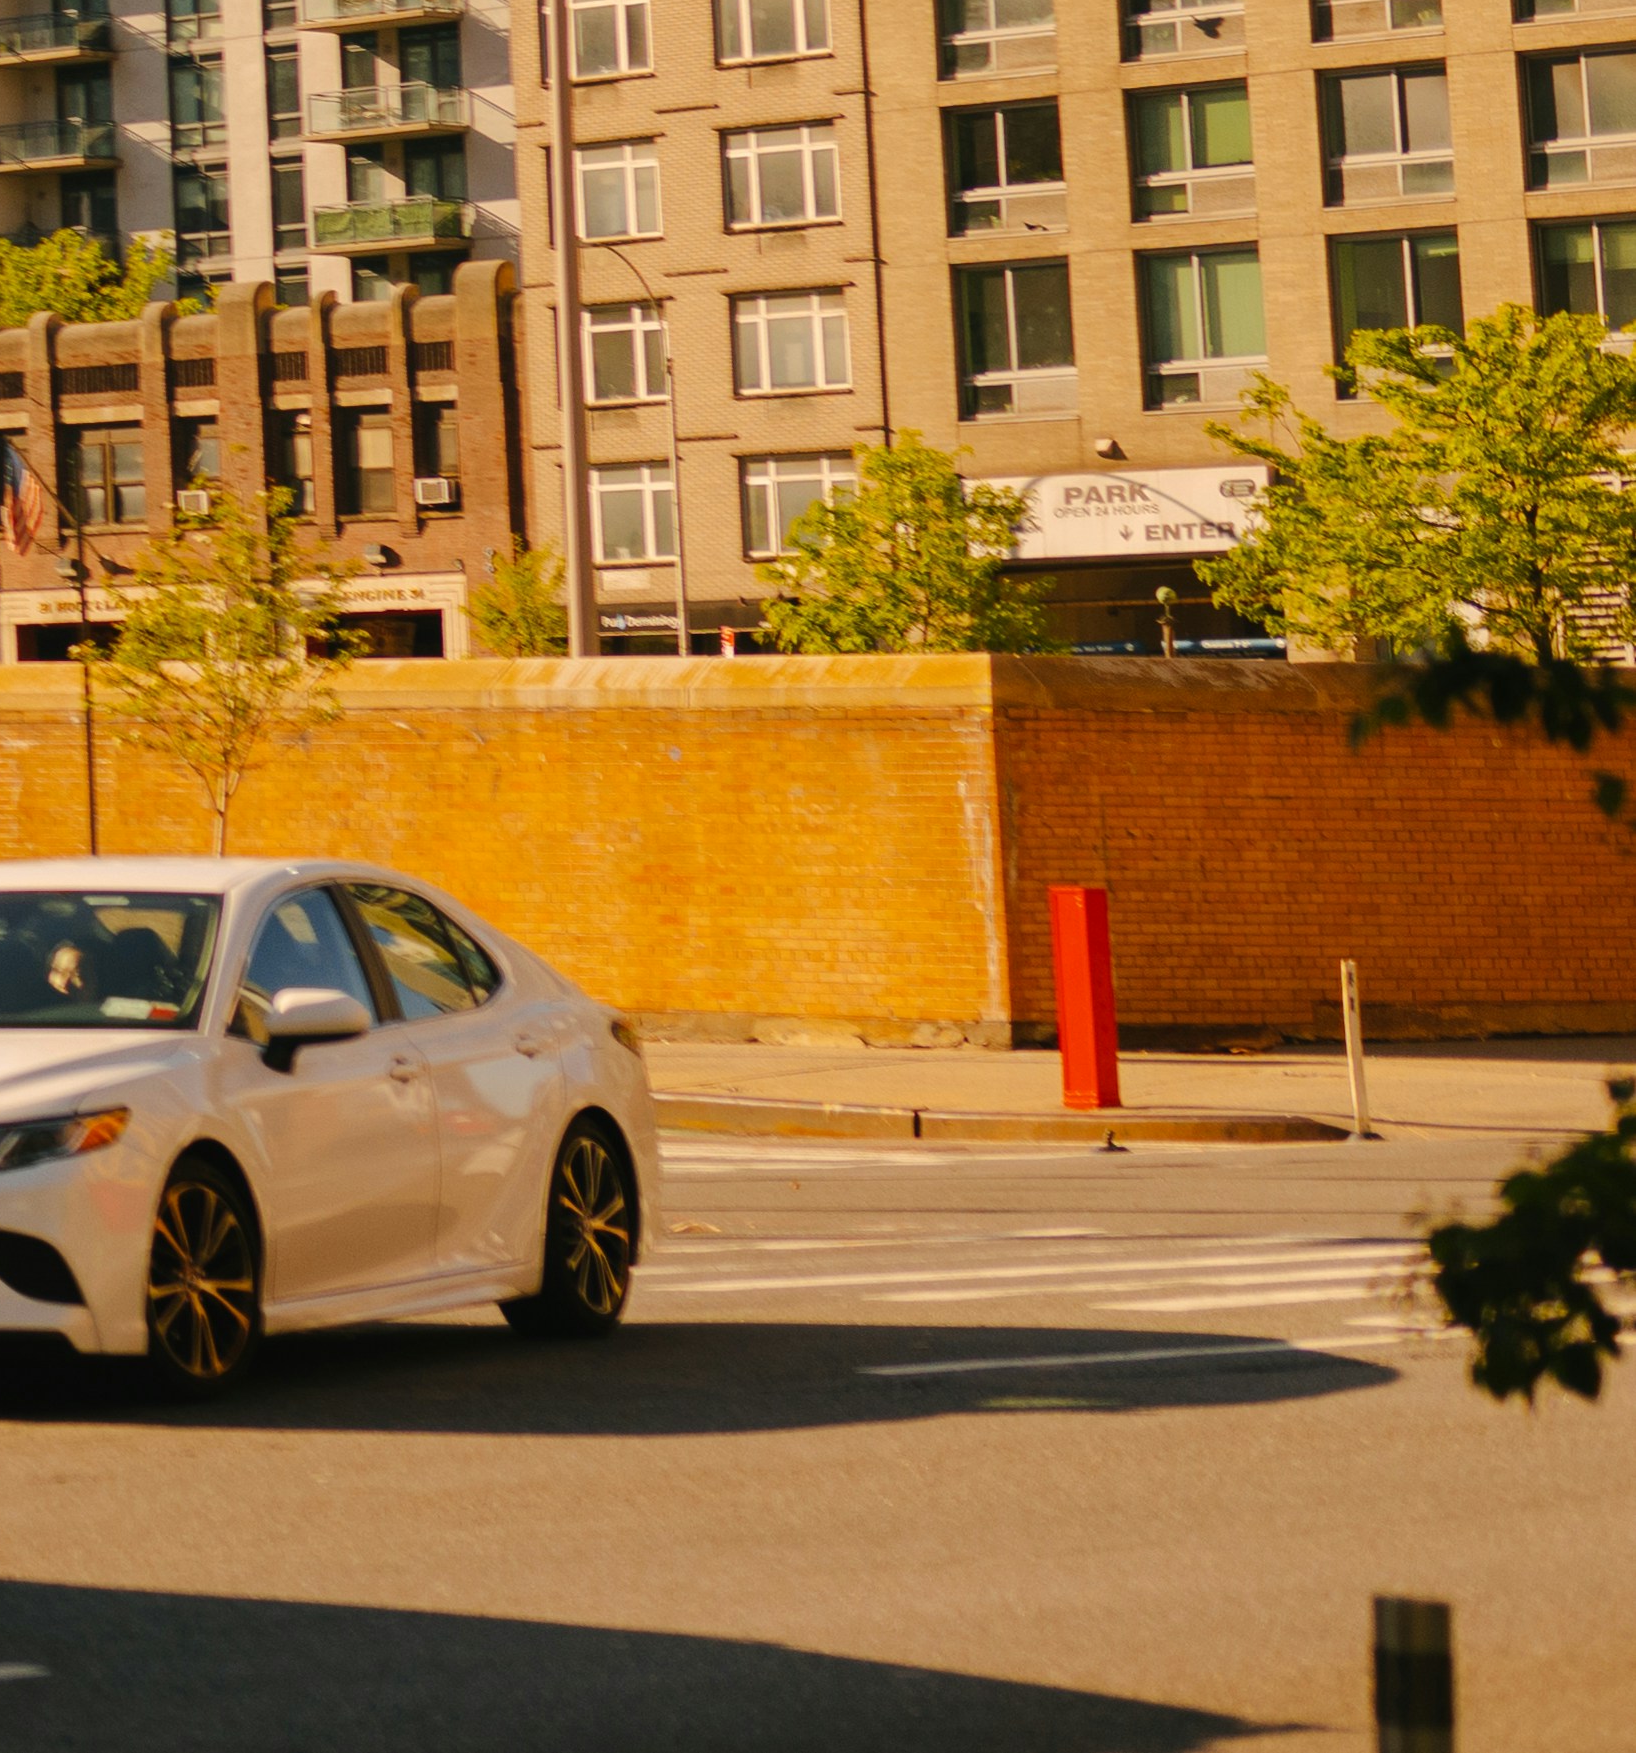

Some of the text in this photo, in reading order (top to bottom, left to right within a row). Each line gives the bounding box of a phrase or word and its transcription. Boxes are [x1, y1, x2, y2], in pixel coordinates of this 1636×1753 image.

[1064, 483, 1150, 505] PARK
[1054, 503, 1160, 519] OPEN 24 HOURS
[1145, 523, 1235, 541] ENTER
